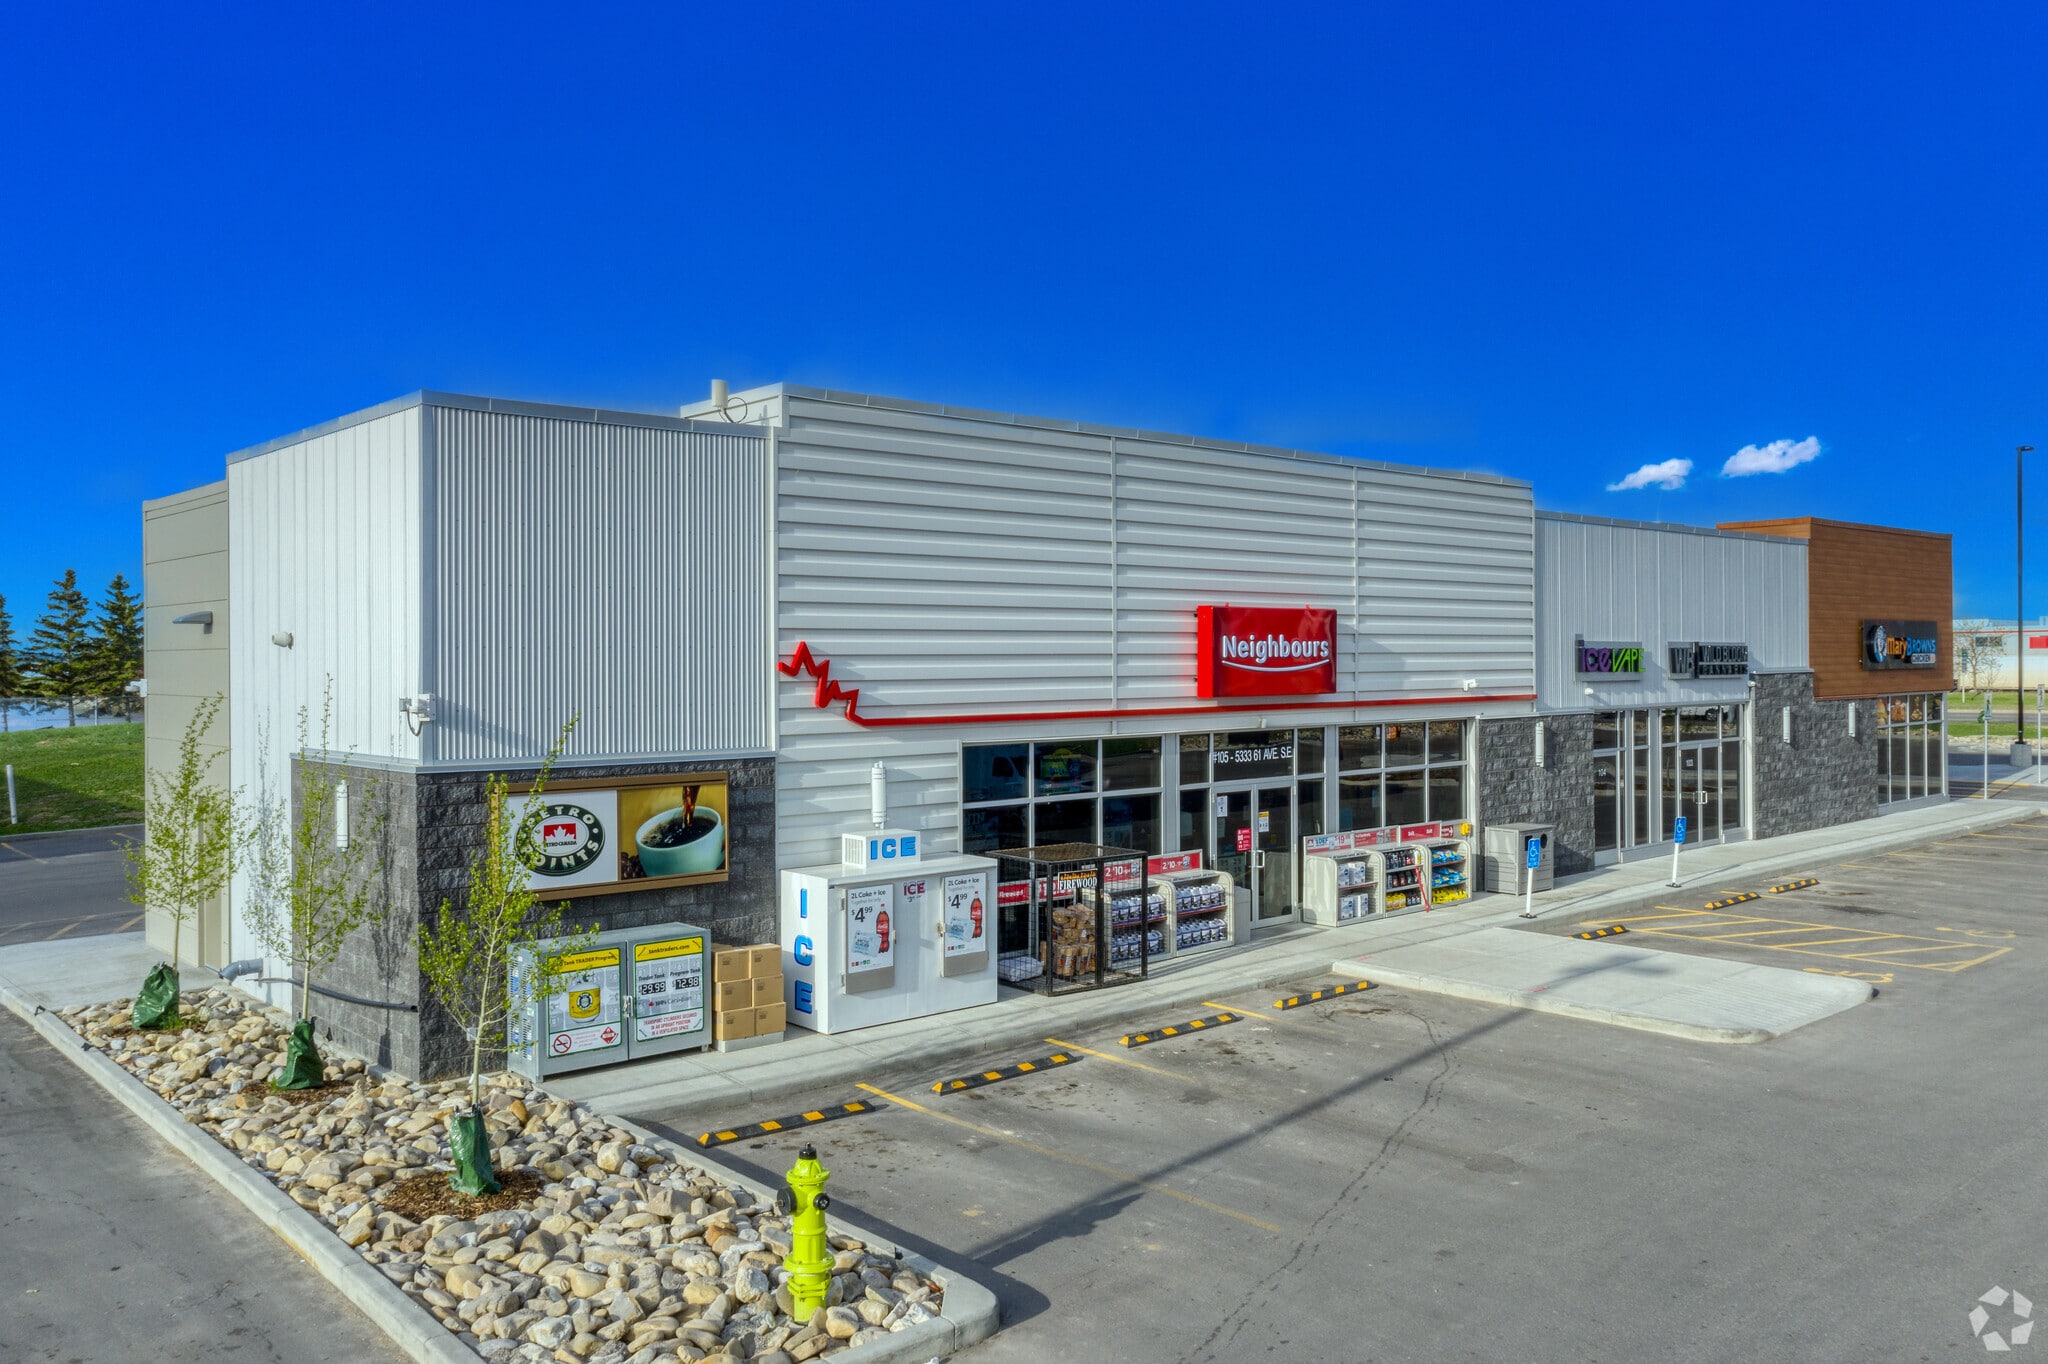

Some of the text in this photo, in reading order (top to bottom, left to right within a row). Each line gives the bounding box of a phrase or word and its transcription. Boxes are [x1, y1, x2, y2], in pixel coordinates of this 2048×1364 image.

[1222, 634, 1329, 663] Neighbours
[1235, 749, 1252, 763] 5333
[1253, 748, 1262, 761] 61
[544, 840, 577, 848] ETRO-CANADA
[870, 836, 916, 860] ICE
[903, 881, 925, 896] ICE
[1059, 876, 1098, 890] FIREWOOD
[648, 944, 690, 954] tanktraders.com
[794, 888, 813, 1014] ICE
